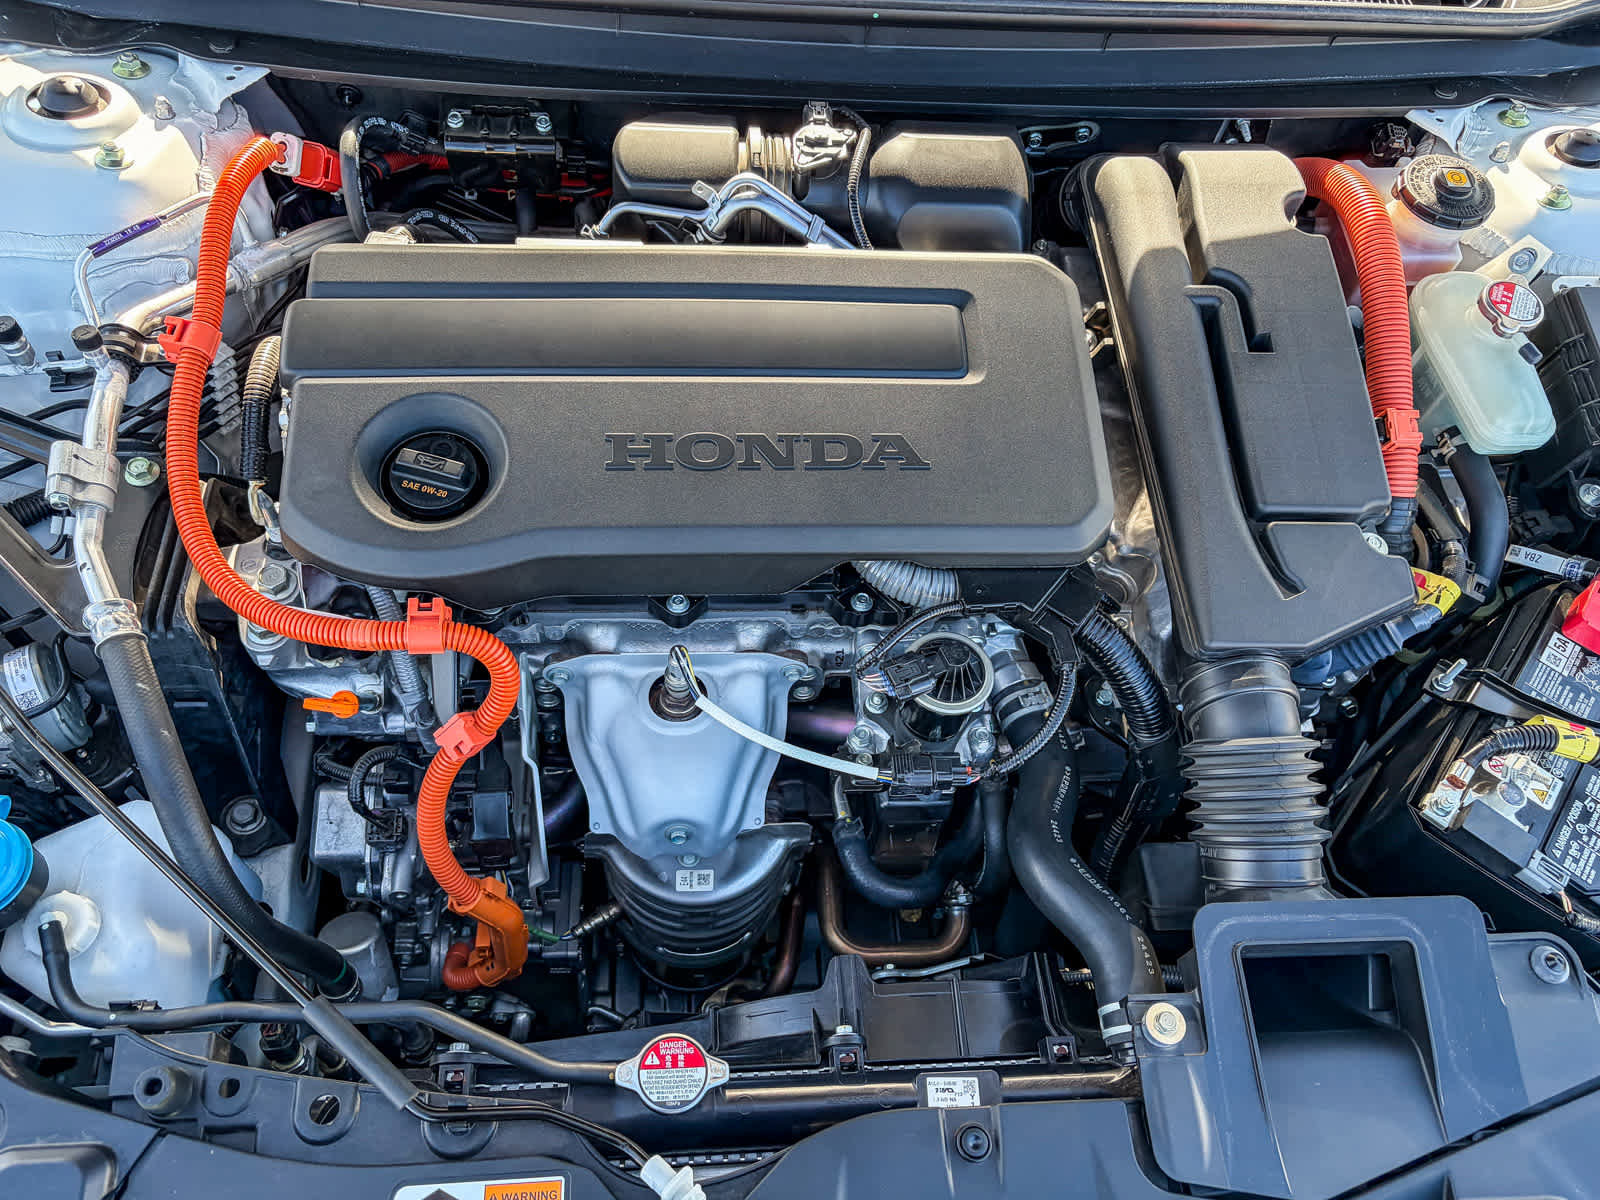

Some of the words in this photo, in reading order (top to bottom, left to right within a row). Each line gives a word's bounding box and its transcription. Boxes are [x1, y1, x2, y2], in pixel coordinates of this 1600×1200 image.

[604, 431, 932, 471] HONDA
[401, 480, 421, 491] SAE
[421, 486, 448, 498] 0W-20
[1553, 637, 1570, 653] 5A
[501, 1189, 558, 1200] WARNING
